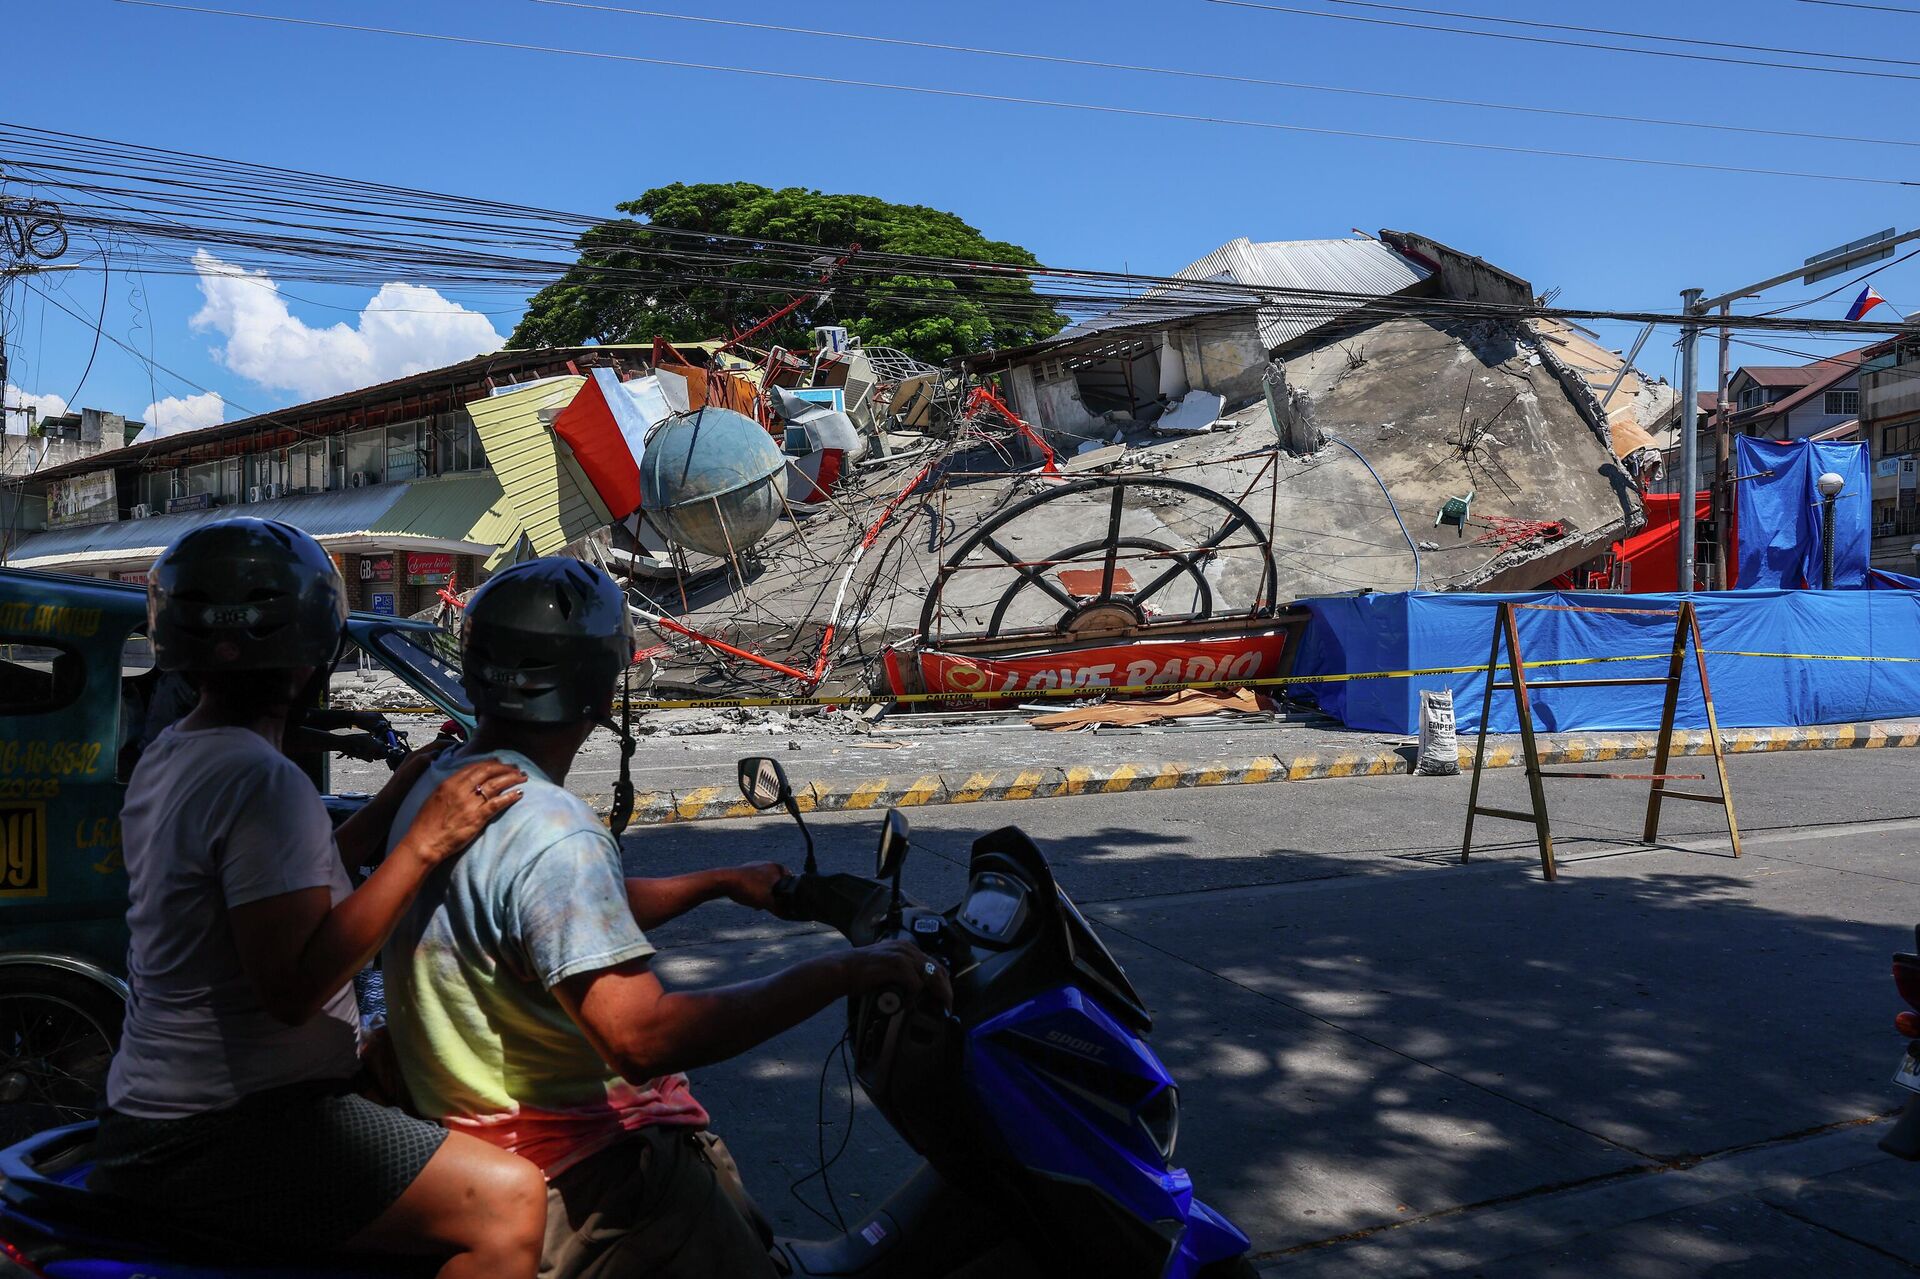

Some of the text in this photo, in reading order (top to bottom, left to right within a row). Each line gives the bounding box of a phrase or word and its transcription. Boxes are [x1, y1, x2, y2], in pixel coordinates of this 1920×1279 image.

[360, 559, 372, 580] GB
[375, 596, 382, 605] P
[1000, 651, 1263, 692] LOVE RADIO
[1046, 1030, 1105, 1056] SPORT
